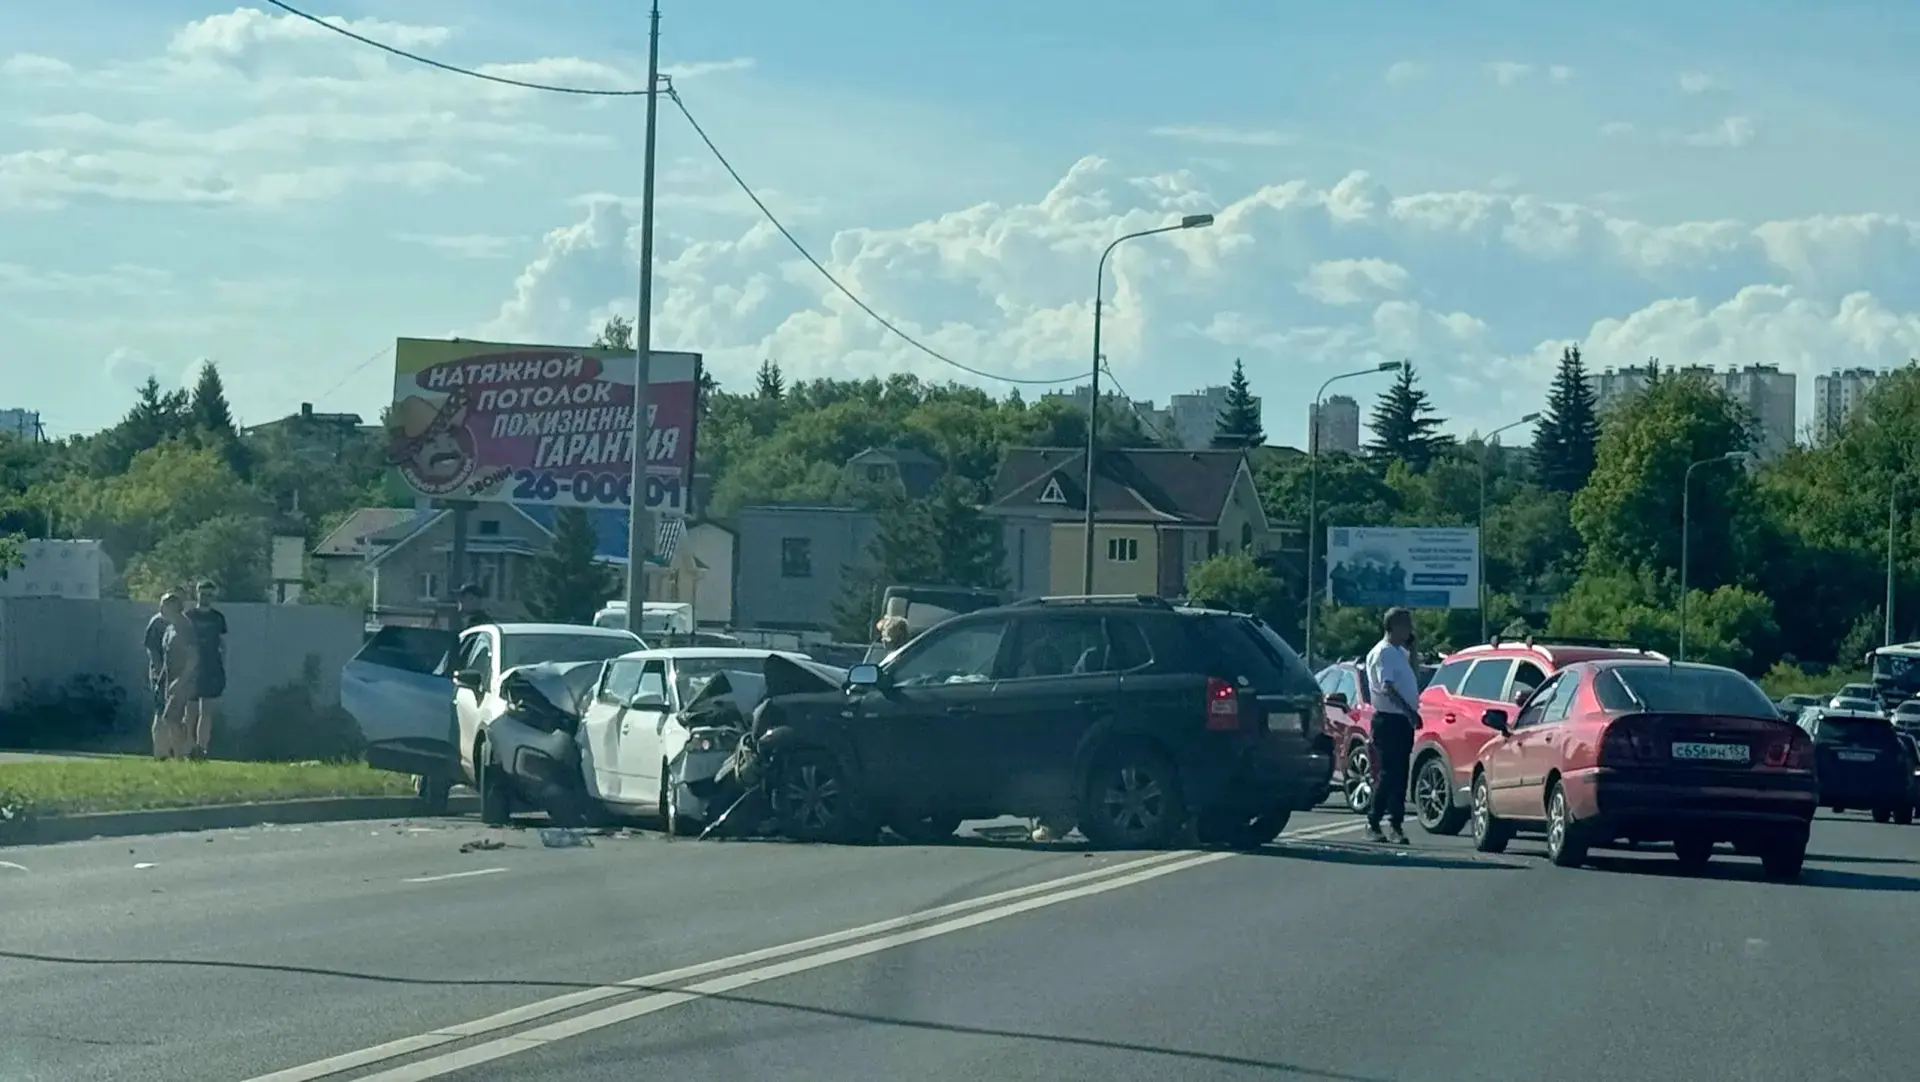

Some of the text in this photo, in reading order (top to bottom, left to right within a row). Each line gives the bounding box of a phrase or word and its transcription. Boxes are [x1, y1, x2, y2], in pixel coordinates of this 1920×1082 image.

[428, 354, 584, 387] НАТЯЖНОЙ
[477, 381, 612, 411] ПОТОЛОК
[534, 427, 680, 467] ГАРАНТИЯ
